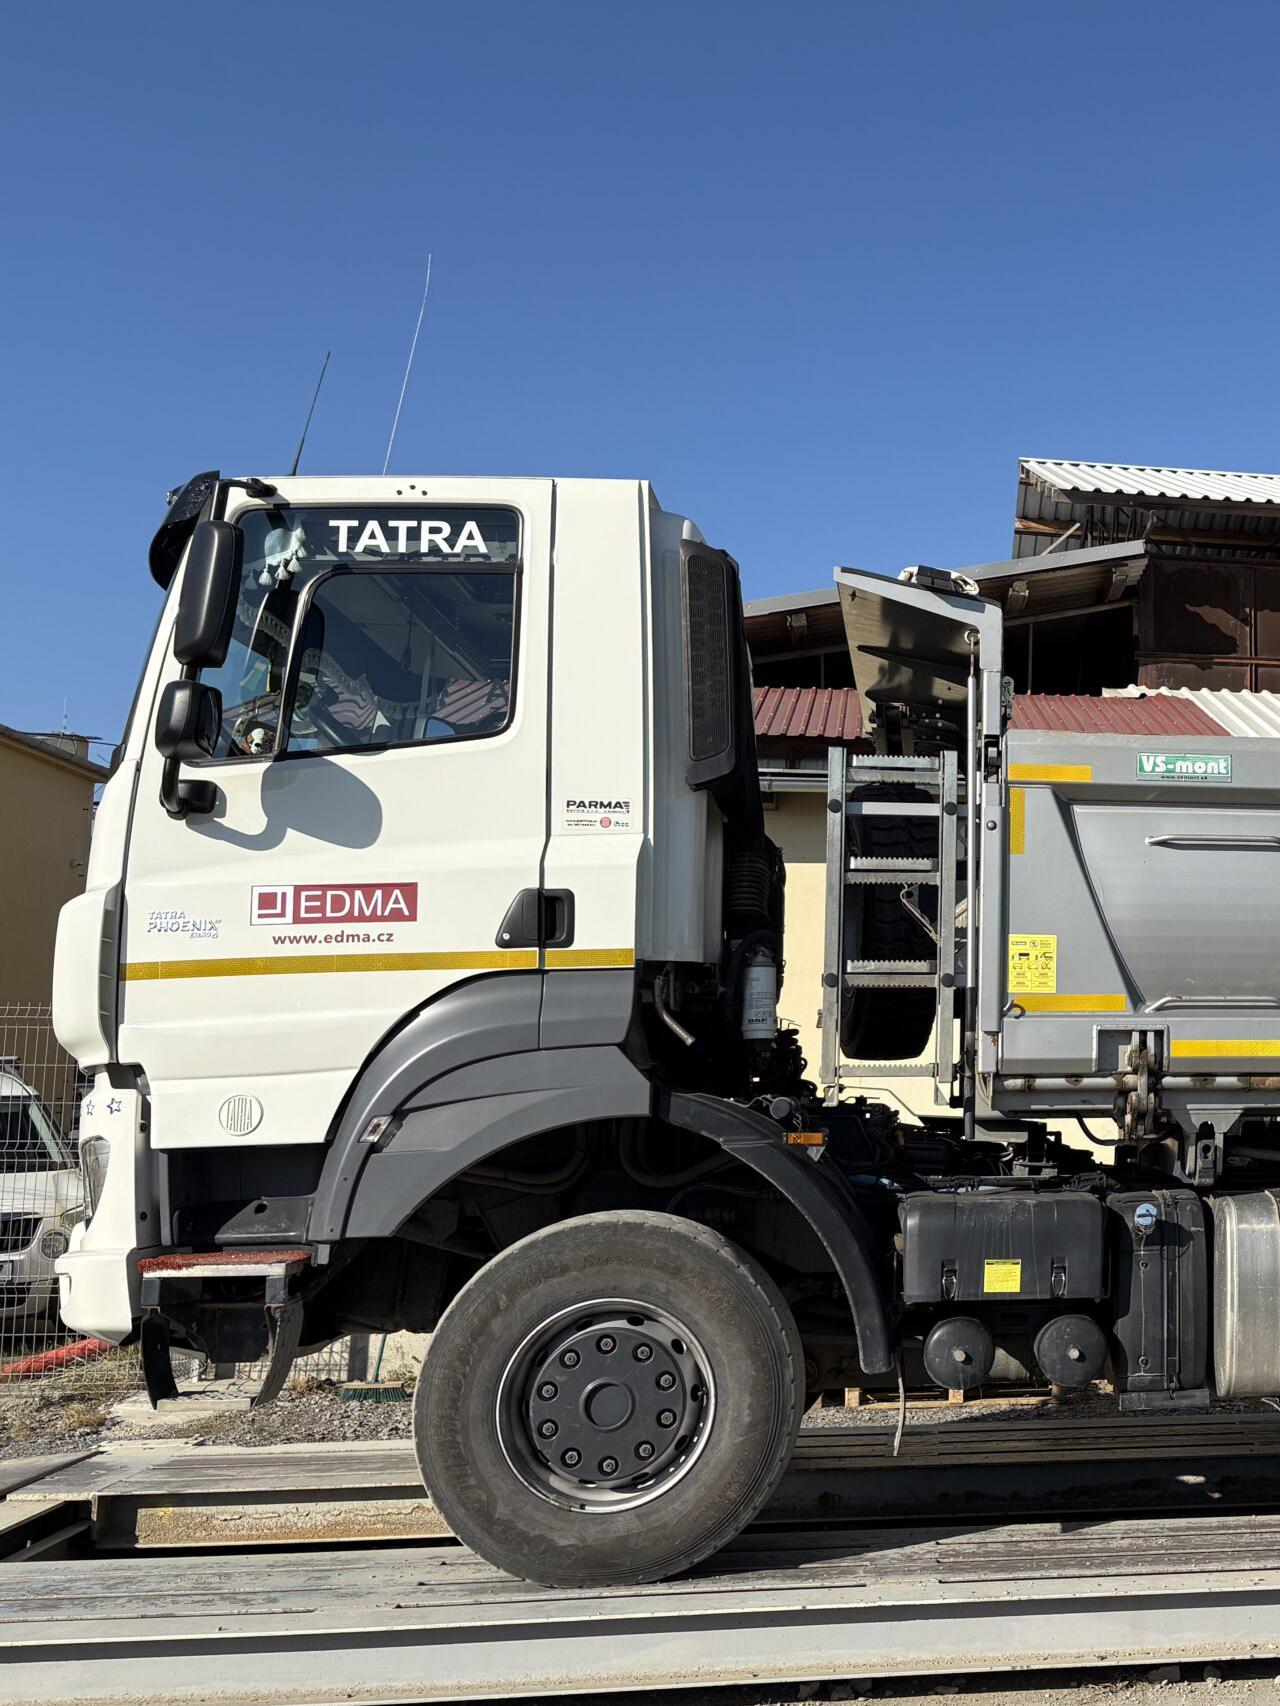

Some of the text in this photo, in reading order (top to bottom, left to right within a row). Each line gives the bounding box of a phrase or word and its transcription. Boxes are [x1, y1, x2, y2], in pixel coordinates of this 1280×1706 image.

[328, 519, 488, 553] TATRA
[1141, 755, 1228, 774] VS-mont
[566, 800, 624, 810] PARMA
[300, 889, 410, 918] EDMA
[147, 911, 186, 920] TATRA
[147, 919, 219, 932] PHOENIX
[272, 930, 394, 945] www.edma.cz
